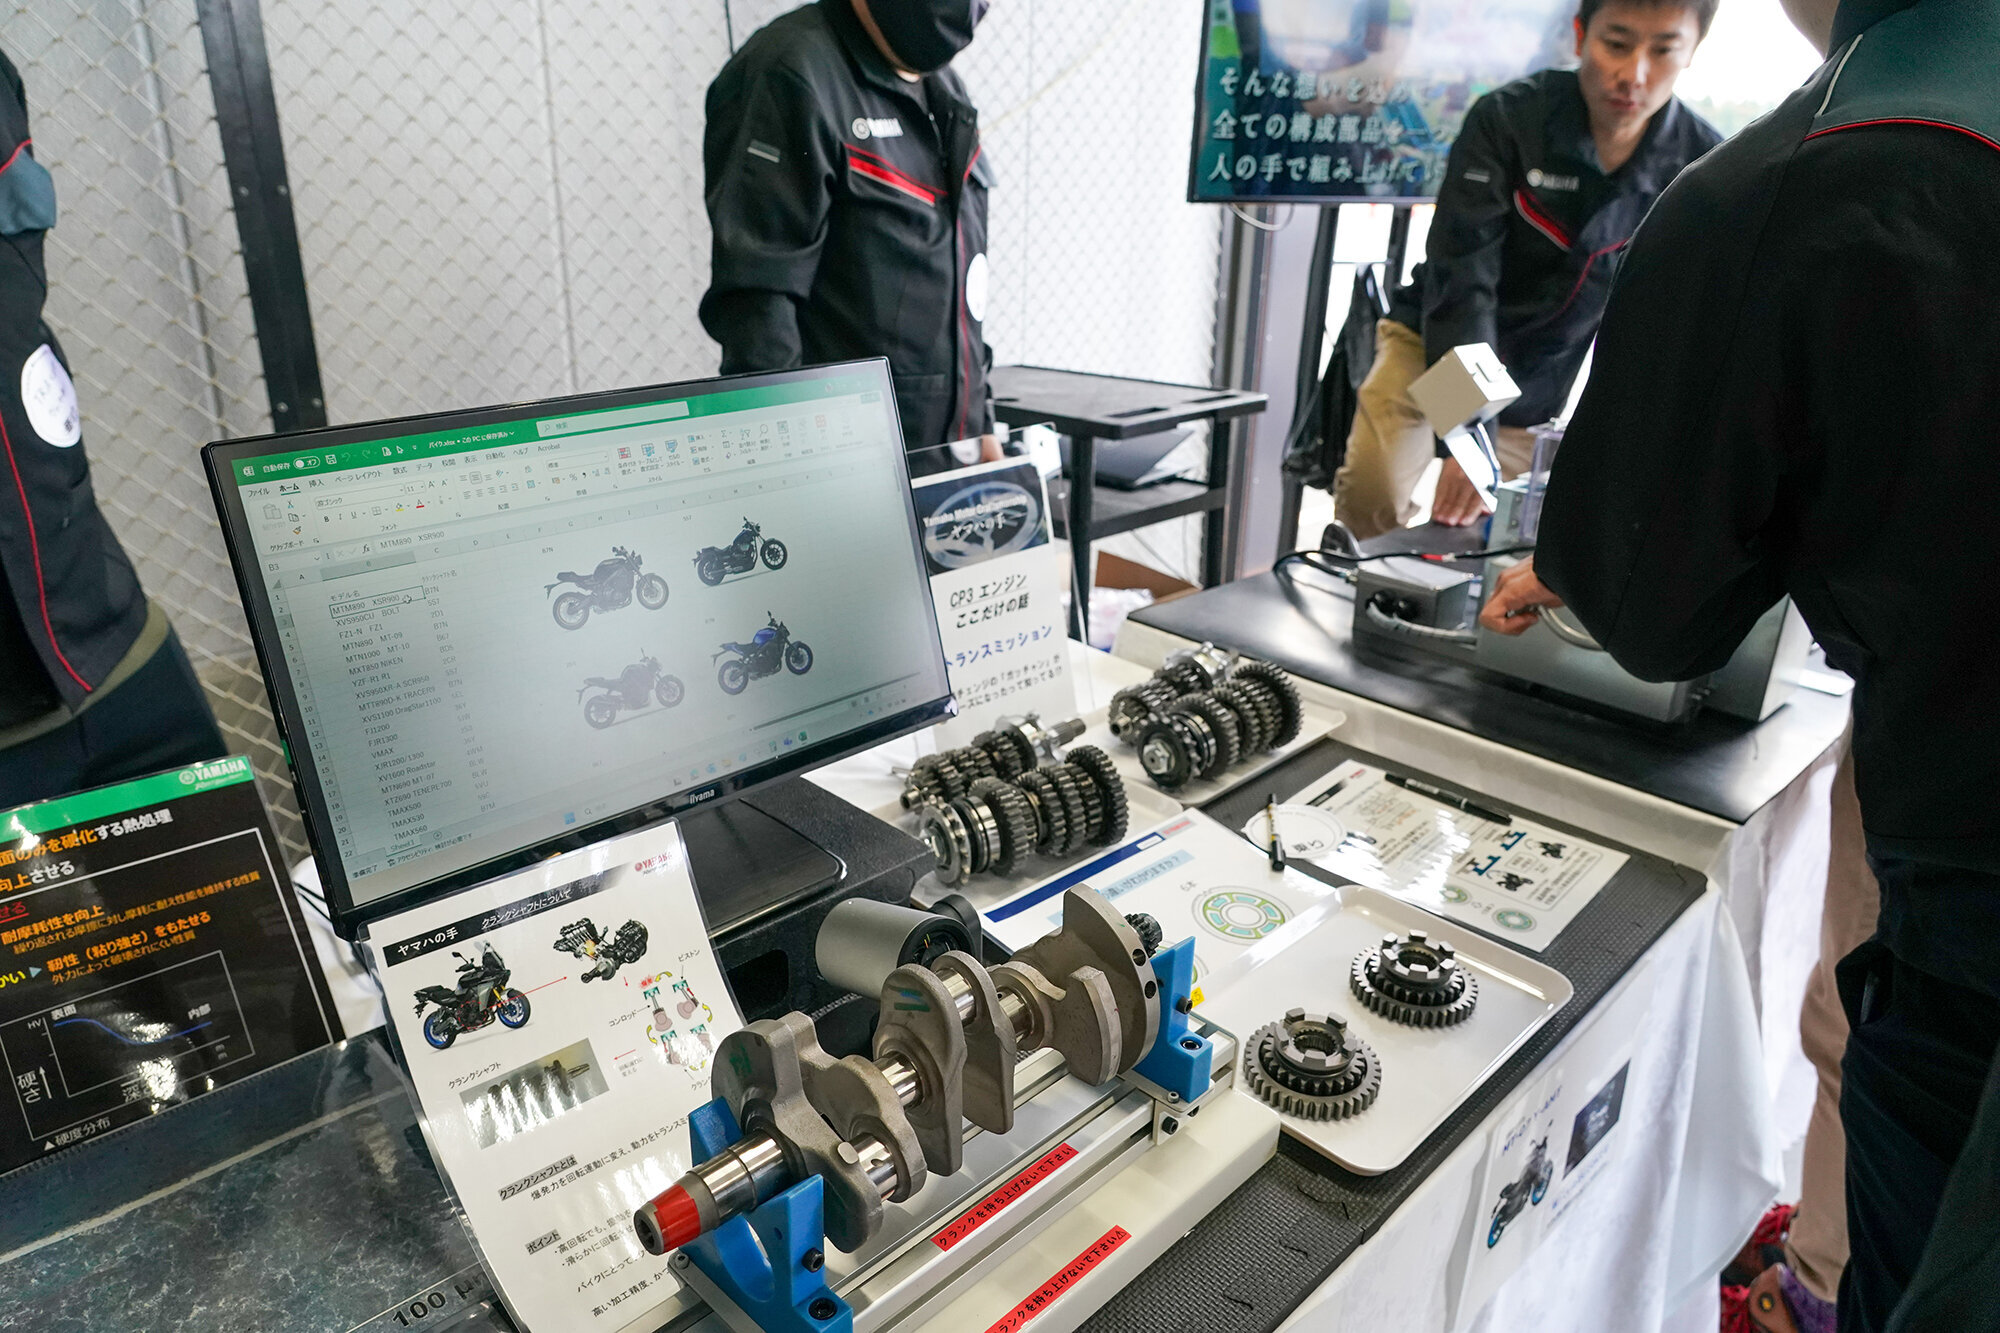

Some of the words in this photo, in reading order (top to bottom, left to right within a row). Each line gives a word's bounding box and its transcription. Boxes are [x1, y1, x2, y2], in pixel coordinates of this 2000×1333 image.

[248, 488, 270, 497] ファイル
[279, 483, 300, 492] ホーム
[309, 479, 324, 488] 挿入
[415, 462, 433, 471] データ
[464, 454, 478, 463] 表示
[485, 451, 506, 461] 自動化
[513, 447, 529, 456] ヘルプ
[537, 443, 561, 452] Acrobat
[263, 462, 290, 473] 自動保存
[380, 537, 412, 549] MTM890
[418, 531, 445, 542] XSR900
[268, 563, 280, 571] B3
[331, 591, 360, 602] モデル名
[950, 587, 974, 608] CP3
[979, 573, 1028, 599] エンジン
[333, 602, 366, 615] MTM890
[371, 595, 400, 606] XSR900
[956, 592, 1030, 629] ここだけの話
[335, 612, 375, 627] XVS950CU
[381, 606, 400, 617] BOLT
[339, 628, 363, 639] FZ1-N
[369, 624, 383, 632] FZ1
[342, 639, 373, 651] MTN890
[946, 626, 1052, 667] ランスミッション
[345, 650, 381, 663] MTN1000
[349, 663, 380, 675] MXT850
[380, 656, 404, 667] NIKEN
[381, 672, 391, 680] R1
[402, 675, 430, 687] SCR950
[402, 686, 436, 701] TRACER9
[362, 709, 395, 724] XVS1100
[365, 723, 390, 736] FJ1200
[368, 734, 398, 747] FJR1300
[371, 747, 395, 760] VMAX
[375, 751, 425, 771] XJR1200/1300
[194, 760, 247, 780] YAMAHA
[378, 769, 406, 782] XV1600
[406, 760, 436, 775] Roadstar
[381, 780, 411, 795] MTN690
[412, 780, 452, 797] TENERE700
[388, 802, 422, 818] TMAX500
[391, 814, 425, 829] TMAX530
[394, 825, 428, 841] TMAX560
[390, 839, 415, 851] Sheet1
[482, 888, 572, 930] クランクシャフトについて
[1, 905, 105, 945] 耐摩耗性を向上
[397, 927, 458, 957] ヤマハの手
[678, 949, 700, 962] ピストン
[51, 1004, 77, 1021] 表面
[609, 1009, 638, 1027] コンロッド
[28, 1019, 42, 1030] HV
[448, 1061, 501, 1089] クランクシャフト
[55, 1118, 111, 1146] 硬度分布
[530, 1117, 688, 1201] 爆発力を回転運動に変え、動力をトランスミ
[499, 1155, 578, 1200] クランクシャフトとは
[938, 1146, 1073, 1247] クランクを持ち上げないで下さい
[525, 1231, 561, 1253] ポイント
[994, 1236, 1118, 1333] ランクを持ち上げないで下さい
[393, 1292, 446, 1327] 100
